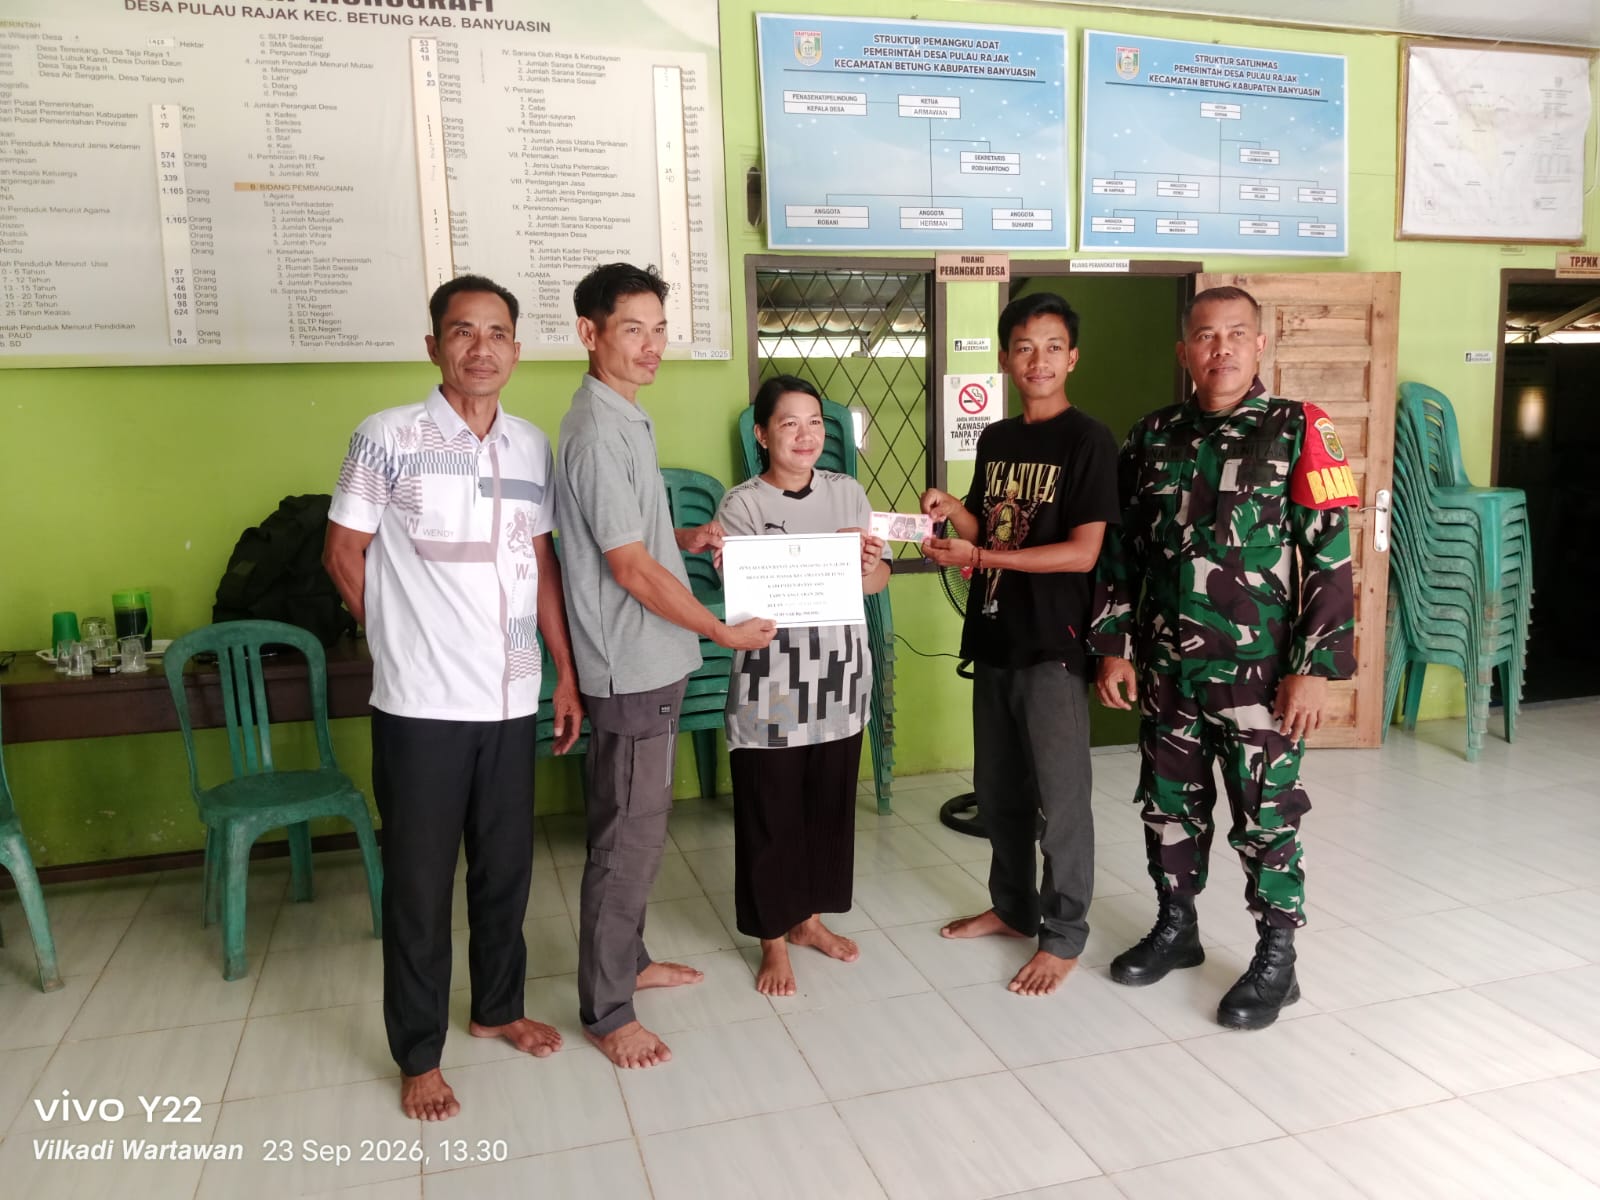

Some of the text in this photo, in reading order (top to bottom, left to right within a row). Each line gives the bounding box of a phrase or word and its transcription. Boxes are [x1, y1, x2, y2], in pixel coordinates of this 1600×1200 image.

[125, 0, 551, 33] DESA PULAU RAJAK KEC. BETUNG KAB. BANYUASIN
[874, 34, 1000, 50] STRUKTUR PEMANGKU ADAT
[863, 47, 1010, 63] PEMERINTAH DESA PULAU RAJAK
[1195, 54, 1278, 69] STRUKTUR SATLINMAS
[834, 59, 1036, 77] KECAMATAN BETUNG KABUPATEN BANYUASIN
[1174, 64, 1297, 83] PEMERINTAH DESA PULAU RAJAK
[1149, 74, 1320, 97] KECAMATAN BETUNG KABUPATEN BANYUASIN
[160, 151, 175, 159] 574
[919, 219, 948, 227] HERMAN
[961, 256, 985, 264] RUANG
[940, 266, 1006, 276] PERANGKAT DESA
[957, 422, 990, 431] KAWASAN
[950, 430, 972, 439] TANPA
[422, 528, 454, 538] WENDY
[515, 563, 529, 580] W
